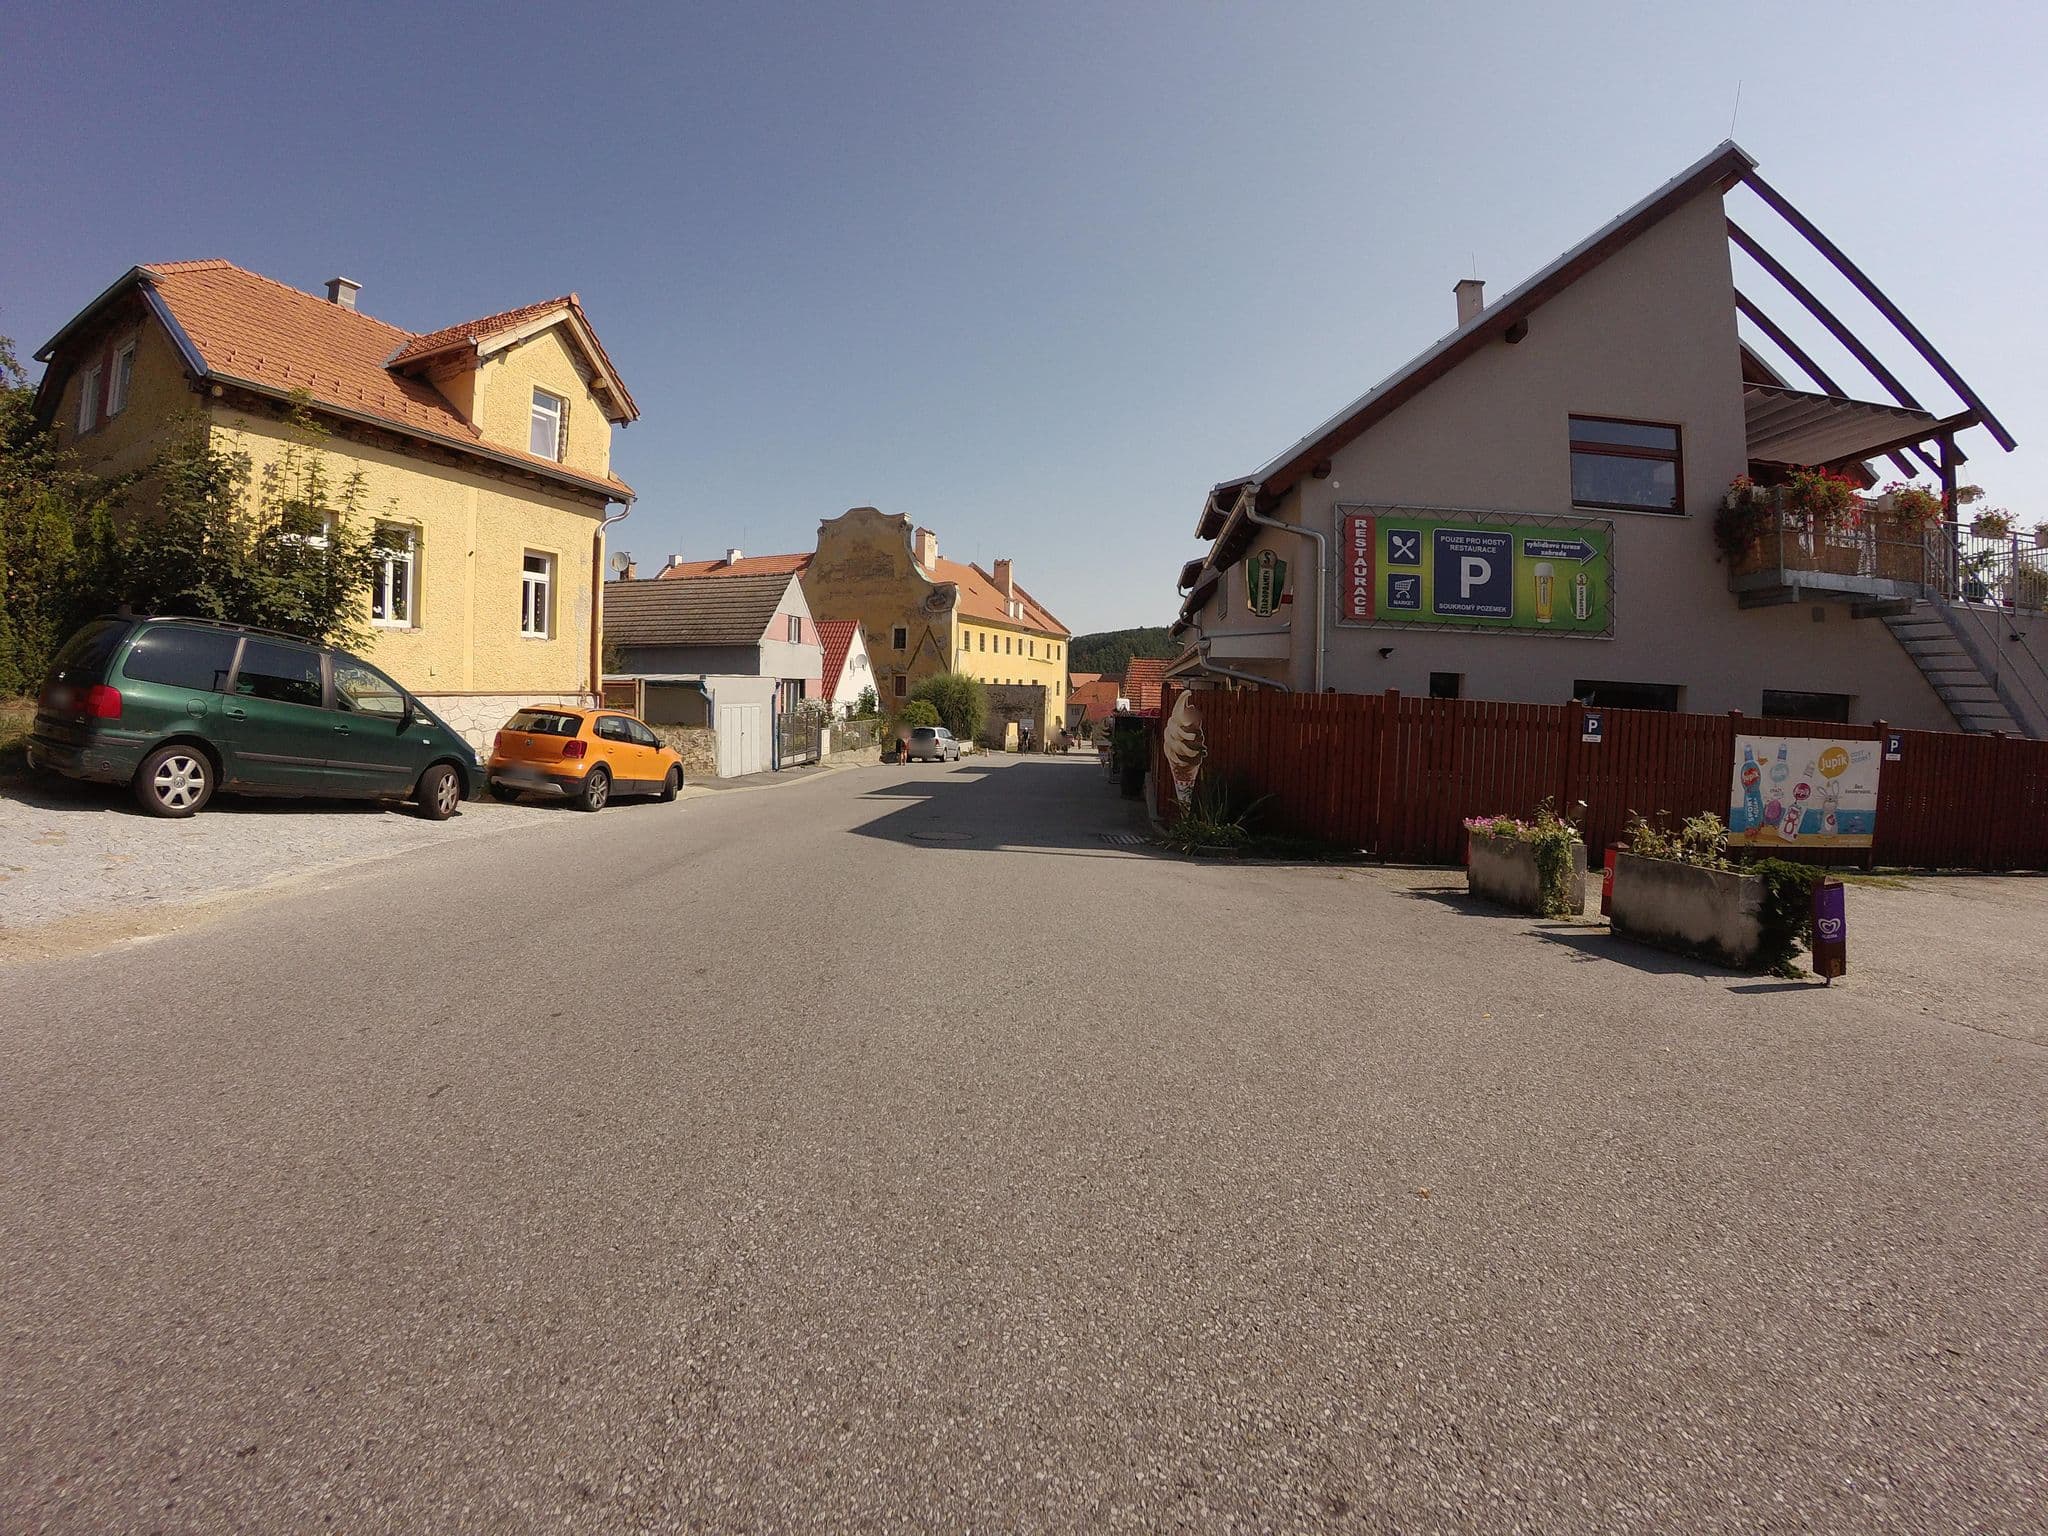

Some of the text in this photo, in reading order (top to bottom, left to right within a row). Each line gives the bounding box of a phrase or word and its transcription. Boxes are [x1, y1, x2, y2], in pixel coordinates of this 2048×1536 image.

[1440, 535, 1506, 547] POUZE PRO HOSTY
[1450, 544, 1497, 554] RESTAURACE
[1354, 519, 1368, 615] RESTAURACE
[1461, 556, 1492, 598] P
[1439, 603, 1507, 613] SOUKROMÝ POZEMEK
[1588, 719, 1598, 733] P
[1891, 740, 1899, 752] P
